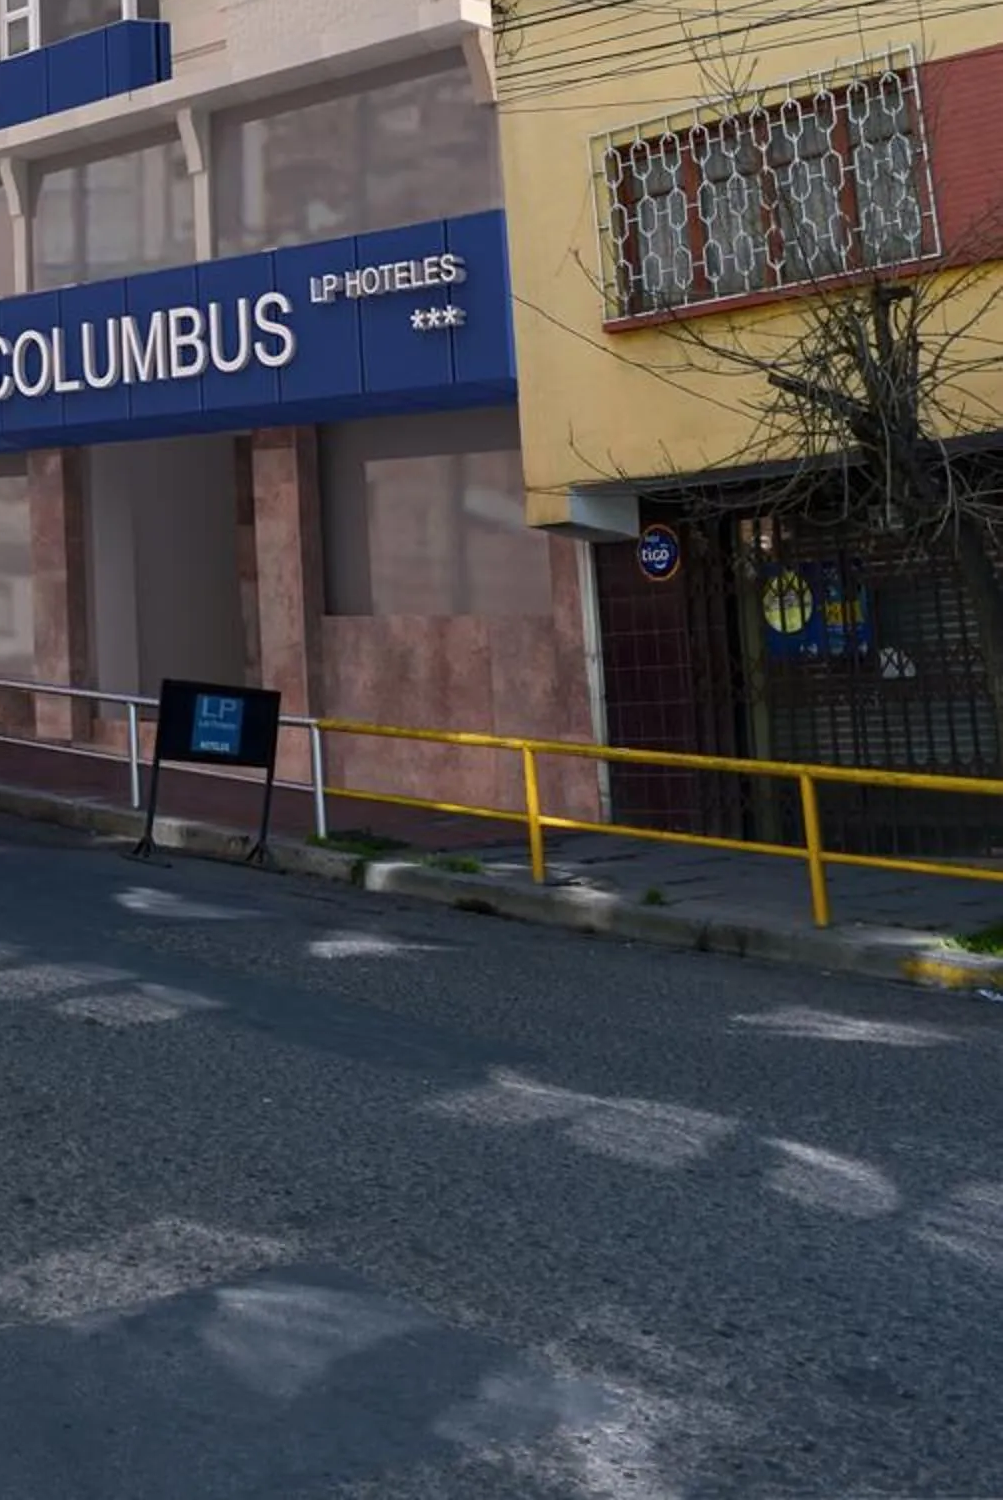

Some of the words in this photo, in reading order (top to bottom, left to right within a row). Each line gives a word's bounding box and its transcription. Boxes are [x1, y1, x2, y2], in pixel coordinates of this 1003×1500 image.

[309, 273, 339, 303] LP
[345, 253, 463, 298] HOTELES
[202, 696, 237, 719] LP
